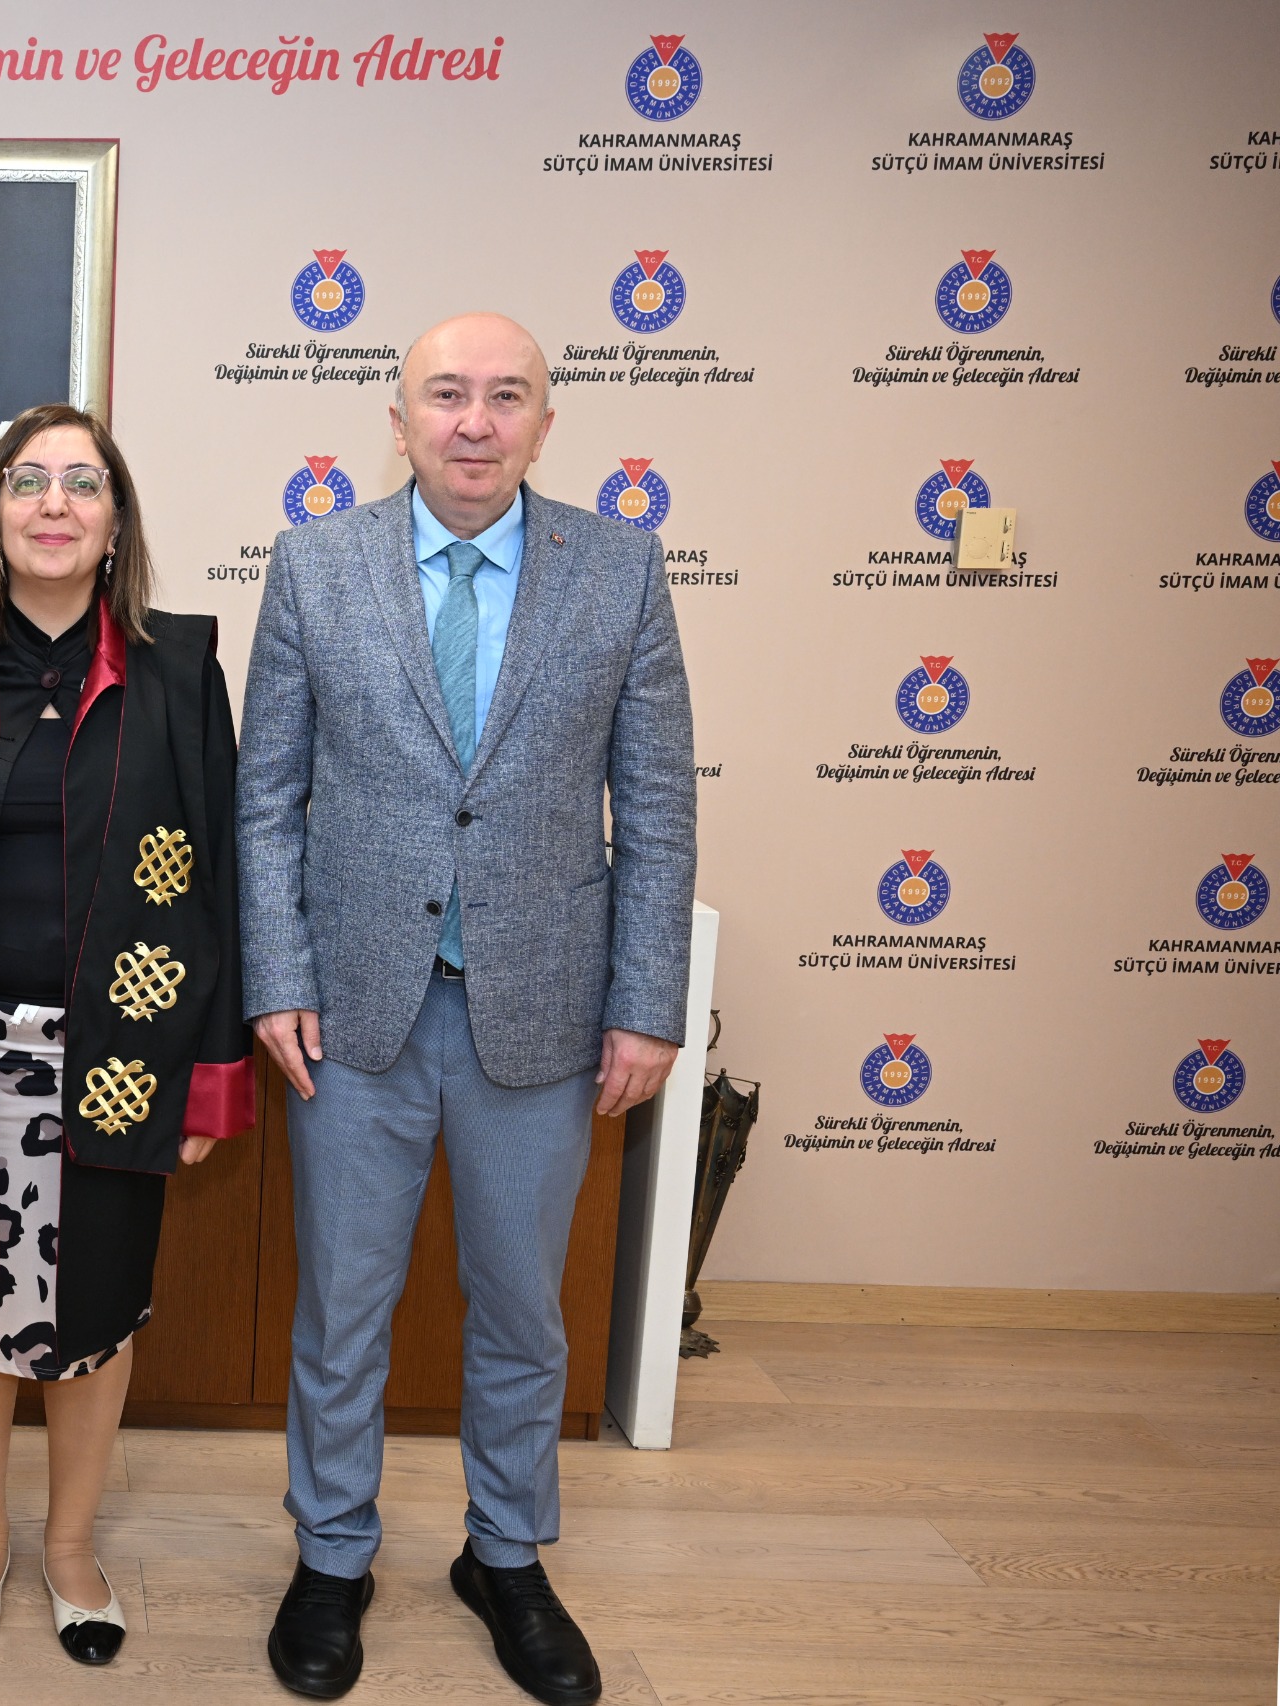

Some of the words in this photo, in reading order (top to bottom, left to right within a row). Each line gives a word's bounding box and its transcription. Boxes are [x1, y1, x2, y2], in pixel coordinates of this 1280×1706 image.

[76, 49, 121, 80] ve
[134, 34, 339, 95] Geleceğin
[353, 34, 504, 87] Adresi
[652, 78, 678, 87] 1992
[984, 77, 1011, 86] 1992
[579, 134, 741, 151] KAHRAMANMARAŞ
[909, 132, 1073, 150] KAHRAMANMARAŞ
[543, 155, 598, 175] SÜTÇÜ
[605, 154, 653, 171] İMAM
[659, 154, 772, 171] ÜNİVERSİTESİ
[872, 153, 928, 174] SÜTÇÜ
[934, 153, 983, 170] İMAM
[989, 153, 1104, 170] ÜNİVERSİTESİ
[1210, 152, 1267, 173] SÜTÇÜ
[637, 292, 663, 301] 1992
[246, 343, 301, 358] Sürekli
[304, 340, 400, 363] Öğrenmenin,
[563, 345, 619, 360] Sürekli
[623, 341, 719, 365] Öğrenmenin,
[886, 345, 943, 361] Sürekli
[946, 341, 1044, 366] Öğrenmenin,
[1219, 345, 1277, 361] Sürekli
[215, 364, 288, 384] Değişimin
[292, 369, 308, 380] ve
[312, 365, 380, 385] Geleceğin
[609, 371, 625, 382] ve
[630, 366, 699, 387] Geleceğin
[704, 367, 755, 384] Adresi
[853, 367, 928, 387] Değişimin
[932, 372, 949, 383] ve
[953, 367, 1024, 387] Geleceğin
[1028, 367, 1080, 385] Adresi
[1185, 367, 1262, 388] Değişimin
[1265, 372, 1280, 383] ve
[868, 550, 1027, 569] KAHRAMAAŞ
[208, 565, 259, 584] SÜTÇÜ
[833, 570, 887, 590] SÜTÇÜ
[893, 570, 940, 586] İMAM
[946, 569, 1057, 587] ÜNİVERSİTESİ
[1159, 572, 1214, 592] SÜTÇÜ
[1220, 572, 1268, 588] İMAM
[848, 744, 903, 759] Sürekli
[906, 741, 1001, 763] Öğrenmenin,
[1170, 747, 1226, 762] Sürekli
[816, 764, 889, 783] Değişimin
[893, 769, 909, 779] ve
[913, 765, 981, 784] Geleceğin
[986, 766, 1036, 782] Adresi
[1137, 767, 1211, 786] Değişimin
[1215, 772, 1231, 782] ve
[1235, 768, 1280, 786] Gelece
[833, 935, 986, 952] KAHRAMANMARAŞ
[1149, 940, 1280, 953] KAHRAMANMAR
[799, 952, 851, 971] SÜTÇÜ
[856, 953, 902, 968] İMAM
[908, 954, 1016, 970] ÜNİVERSİTESİ
[1114, 957, 1167, 976] SÜTÇÜ
[1173, 958, 1219, 973] İMAM
[815, 1115, 868, 1130] Sürekli
[871, 1113, 962, 1135] Öğrenmenin,
[1125, 1122, 1179, 1136] Sürekli
[1183, 1119, 1274, 1141] Öğrenmenin,
[784, 1134, 855, 1152] Değişimin
[858, 1139, 873, 1149] ve
[877, 1136, 943, 1154] Geleceğin
[948, 1137, 996, 1152] Adresi
[1094, 1140, 1165, 1158] Değişimin
[1169, 1146, 1184, 1155] ve
[1188, 1142, 1255, 1160] Geleceğin
